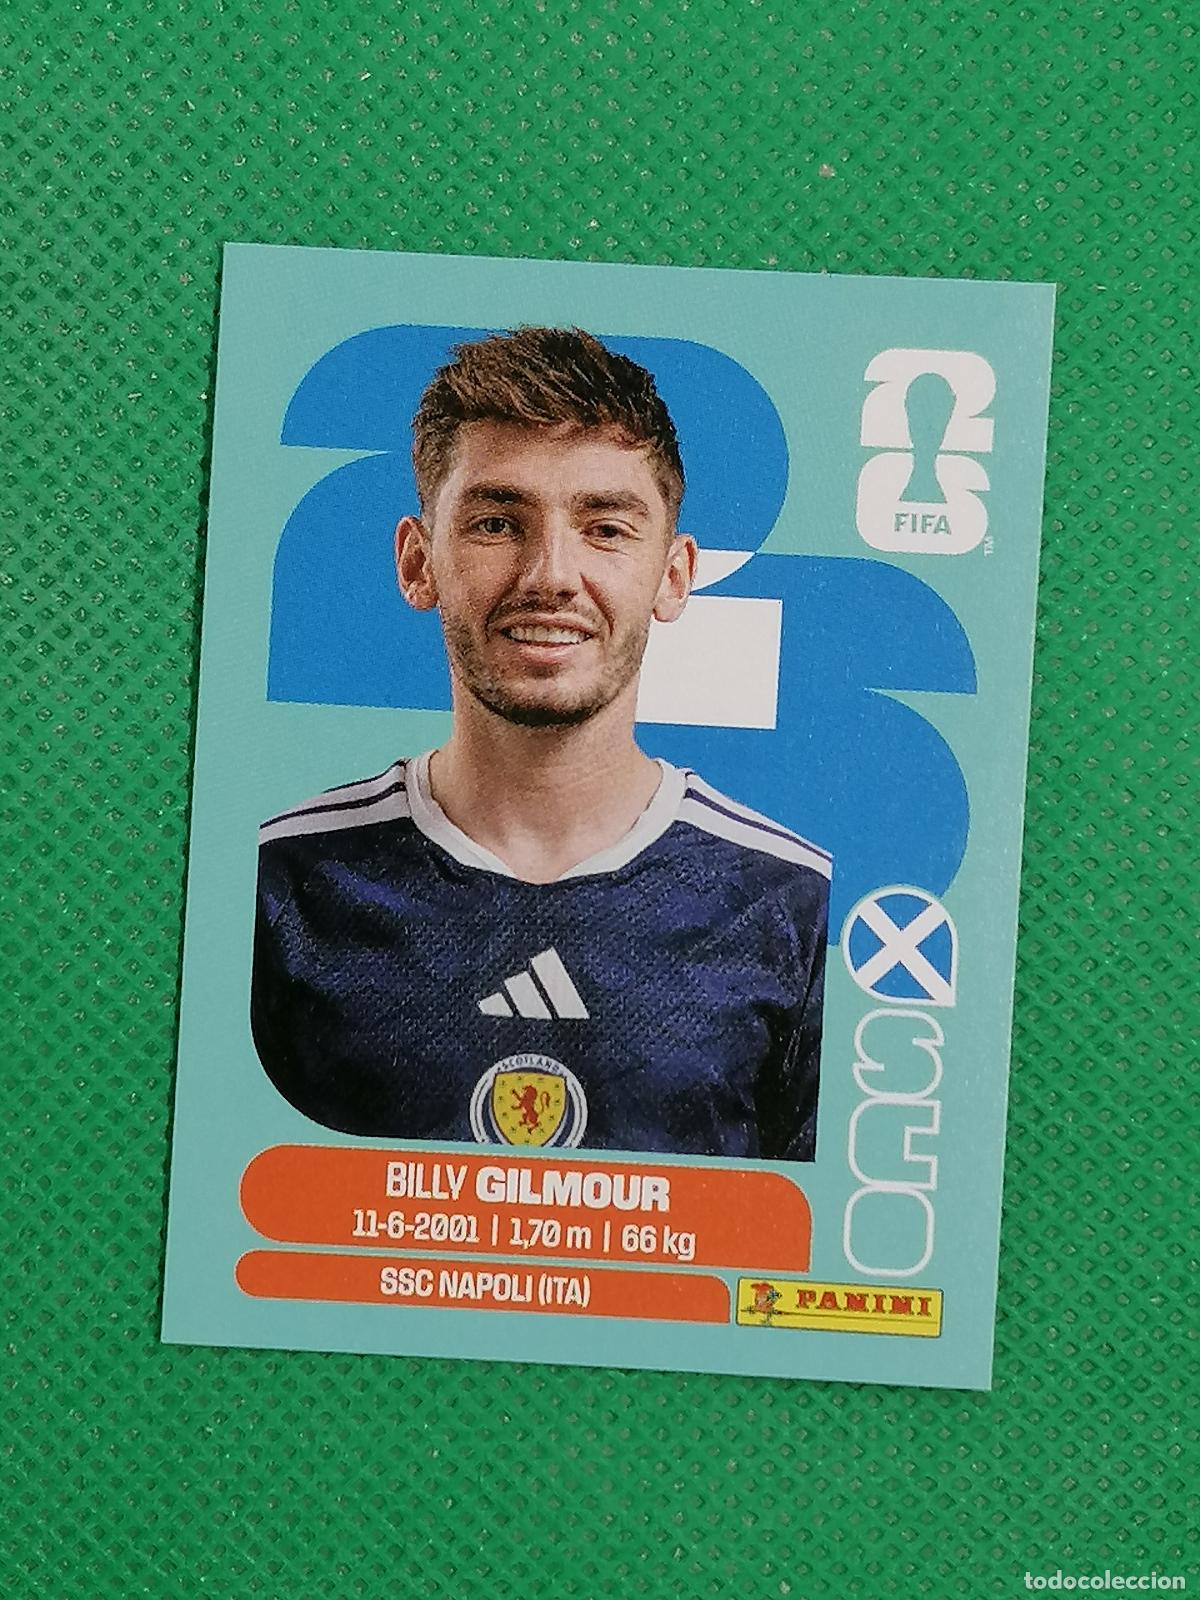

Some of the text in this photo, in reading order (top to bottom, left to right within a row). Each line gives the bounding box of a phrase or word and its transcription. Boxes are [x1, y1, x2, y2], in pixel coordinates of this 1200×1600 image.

[894, 512, 952, 536] FIFA
[501, 1055, 560, 1073] SCOTLAND
[843, 1007, 945, 1278] SCO
[385, 1160, 671, 1213] BILLY GILMOUR
[351, 1208, 480, 1244] 11-6-2001
[509, 1217, 561, 1250] 1,70
[566, 1224, 592, 1250] m
[621, 1223, 656, 1254] 66
[662, 1225, 697, 1261] kg
[380, 1266, 592, 1309] SSC NAPOLI (ITA)
[795, 1287, 933, 1318] PANINI
